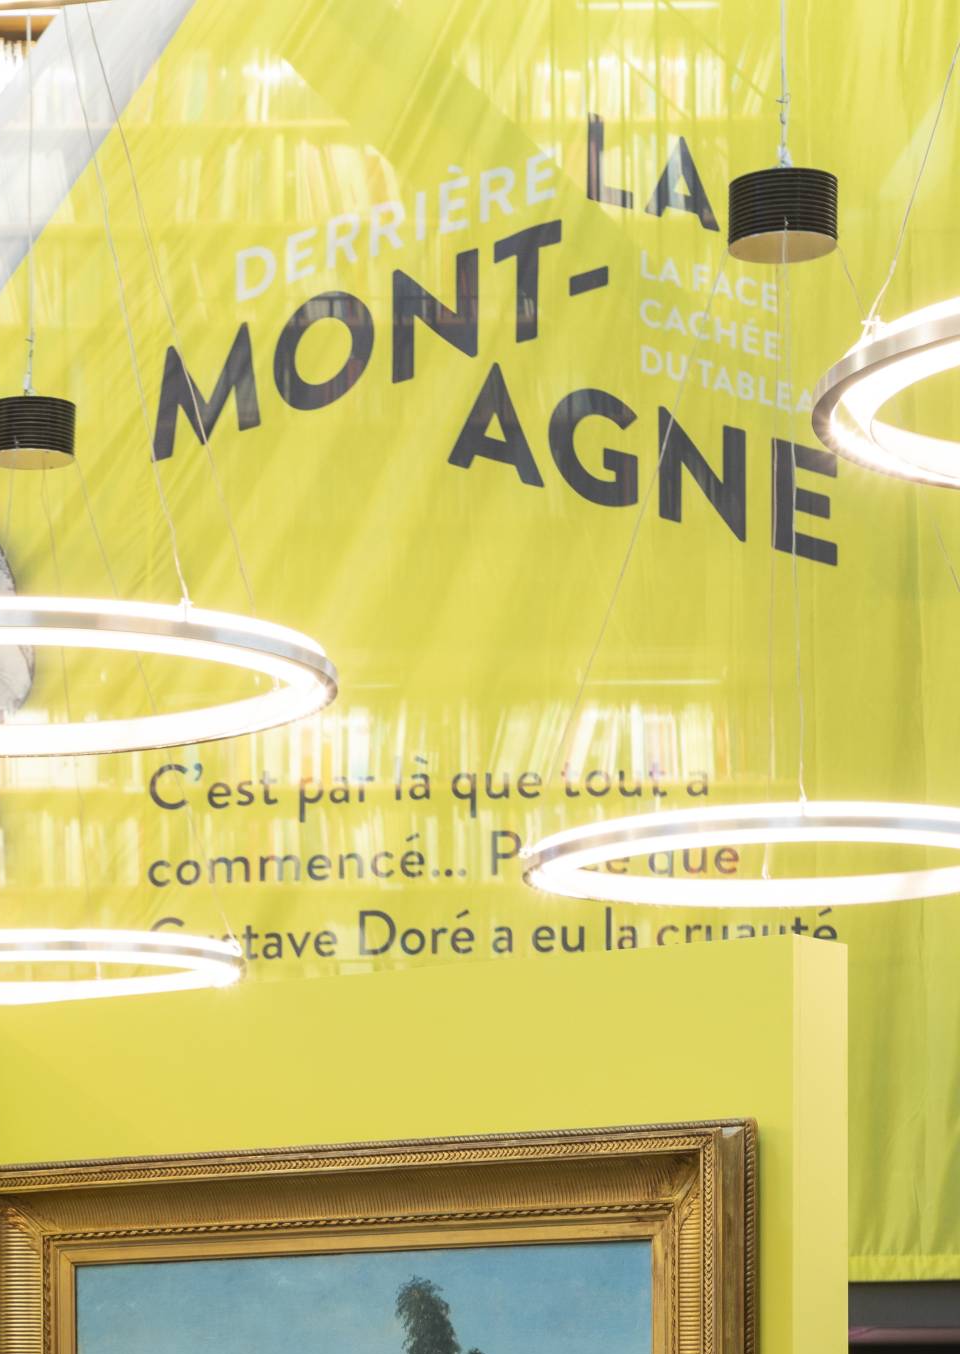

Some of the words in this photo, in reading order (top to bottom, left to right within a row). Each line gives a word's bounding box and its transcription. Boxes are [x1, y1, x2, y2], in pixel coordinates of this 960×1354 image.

[235, 148, 557, 303] DERRIÈRE
[586, 113, 720, 232] LA
[640, 249, 682, 288] LA
[692, 263, 778, 313] FACE
[152, 219, 610, 462] MONT-
[640, 299, 782, 361] CACHÉE
[640, 344, 689, 382] DU
[696, 358, 813, 415] TABLEA
[448, 362, 839, 566] AGNE
[149, 762, 279, 810] C'est
[299, 775, 375, 823] par
[394, 755, 431, 801] là
[450, 769, 543, 819] que
[562, 762, 667, 799] tout
[686, 769, 710, 797] a
[147, 832, 467, 888] commencé...
[648, 845, 740, 877] que
[149, 916, 338, 961] tave
[358, 909, 475, 956] Doré
[491, 925, 514, 954] a
[531, 923, 585, 954] eu
[605, 906, 639, 951] la
